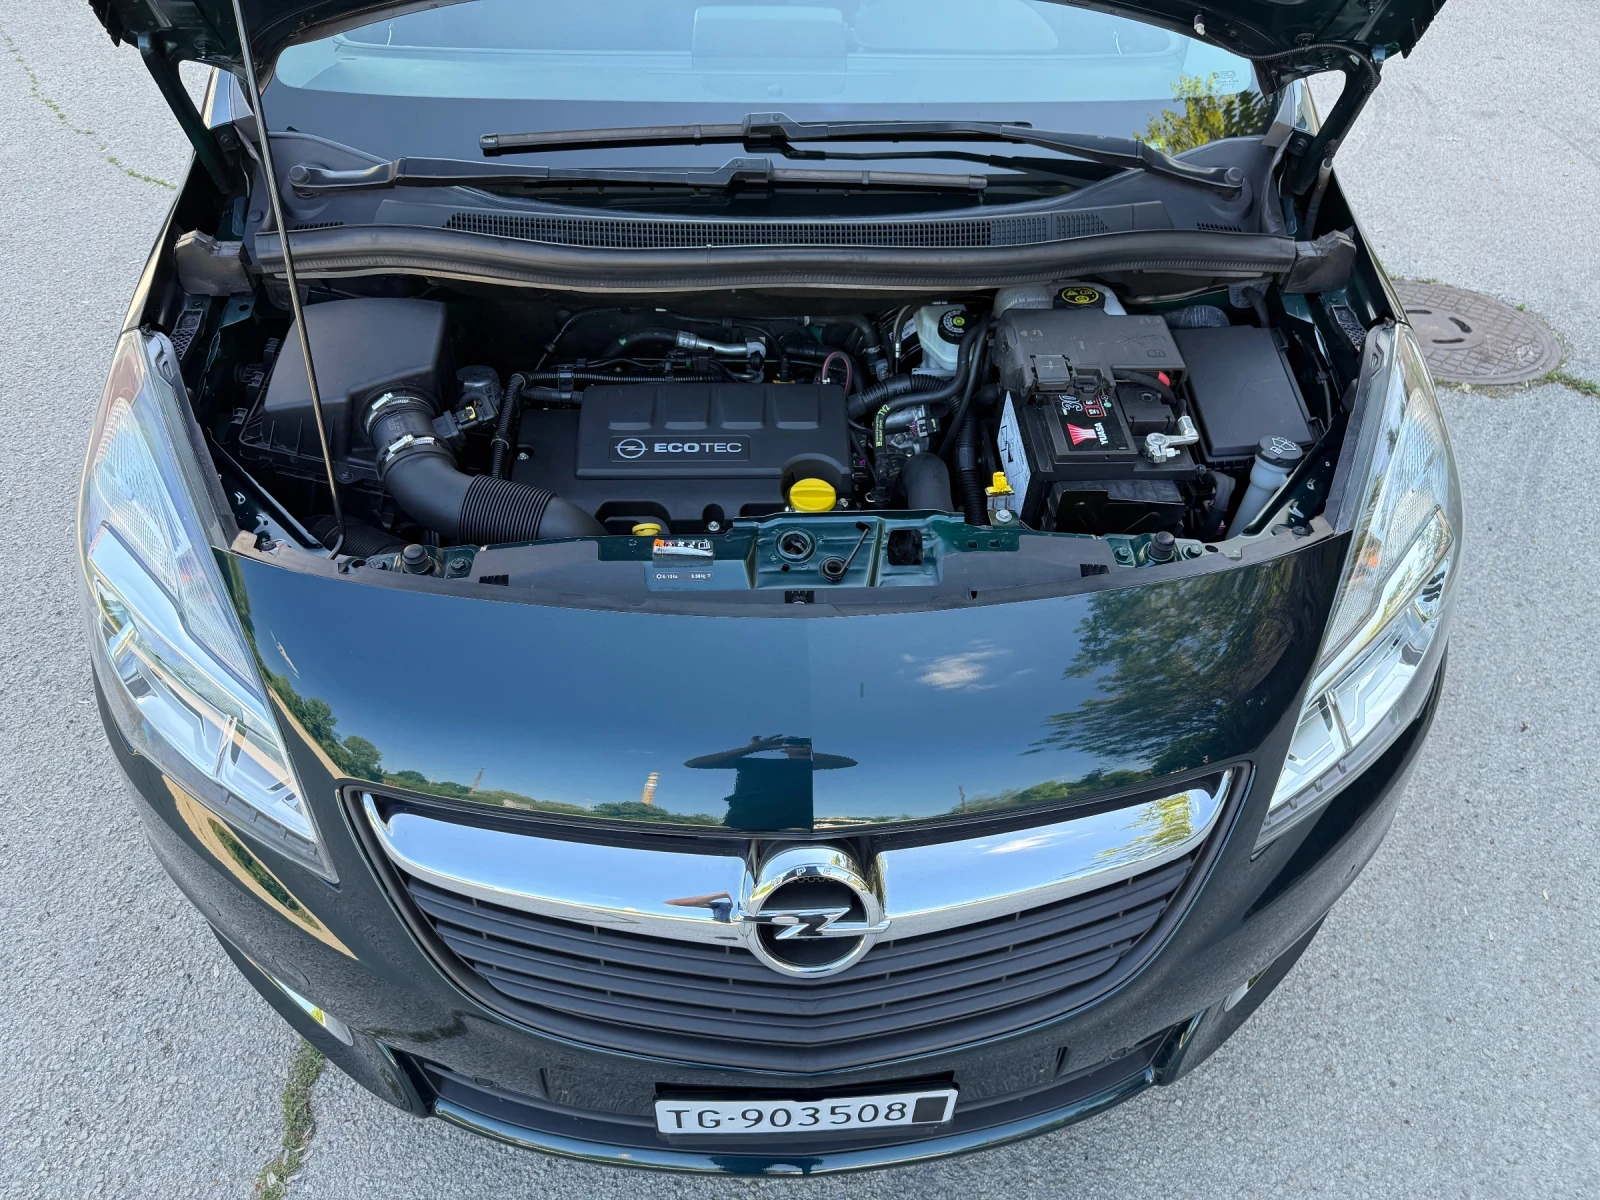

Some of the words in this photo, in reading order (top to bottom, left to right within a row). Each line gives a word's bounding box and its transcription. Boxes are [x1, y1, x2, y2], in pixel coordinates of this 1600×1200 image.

[1094, 422, 1109, 445] YUASA
[654, 442, 742, 453] ECOTEC
[770, 866, 854, 885] OPEL
